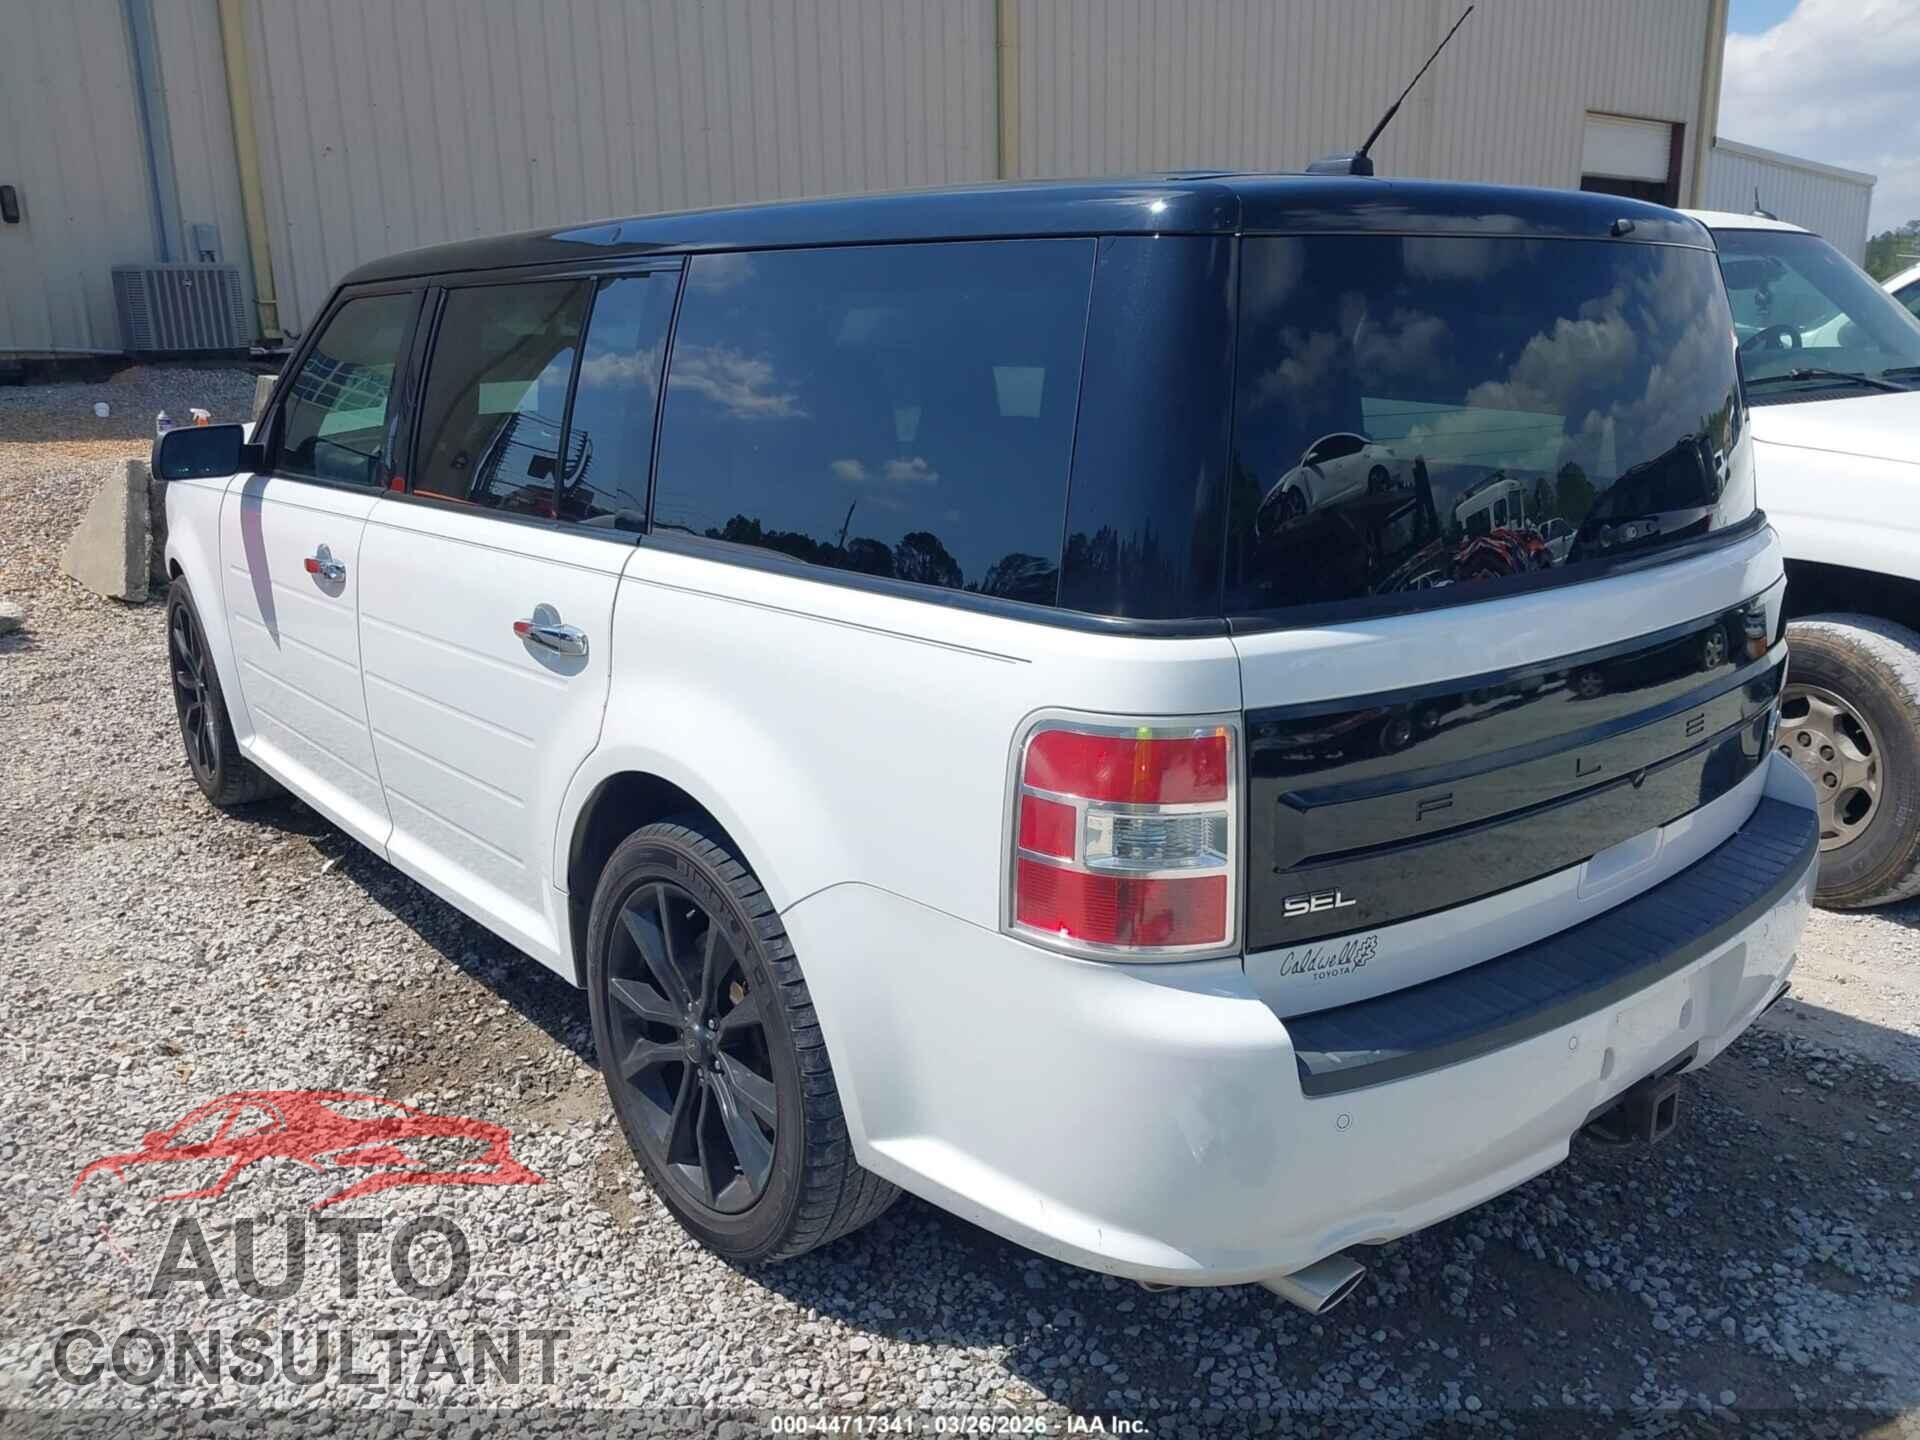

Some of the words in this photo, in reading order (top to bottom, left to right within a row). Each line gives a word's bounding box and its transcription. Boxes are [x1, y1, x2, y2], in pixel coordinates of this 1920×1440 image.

[1282, 888, 1357, 917] SEL
[1280, 939, 1358, 976] Caldwell
[1313, 967, 1350, 980] TOYOTA
